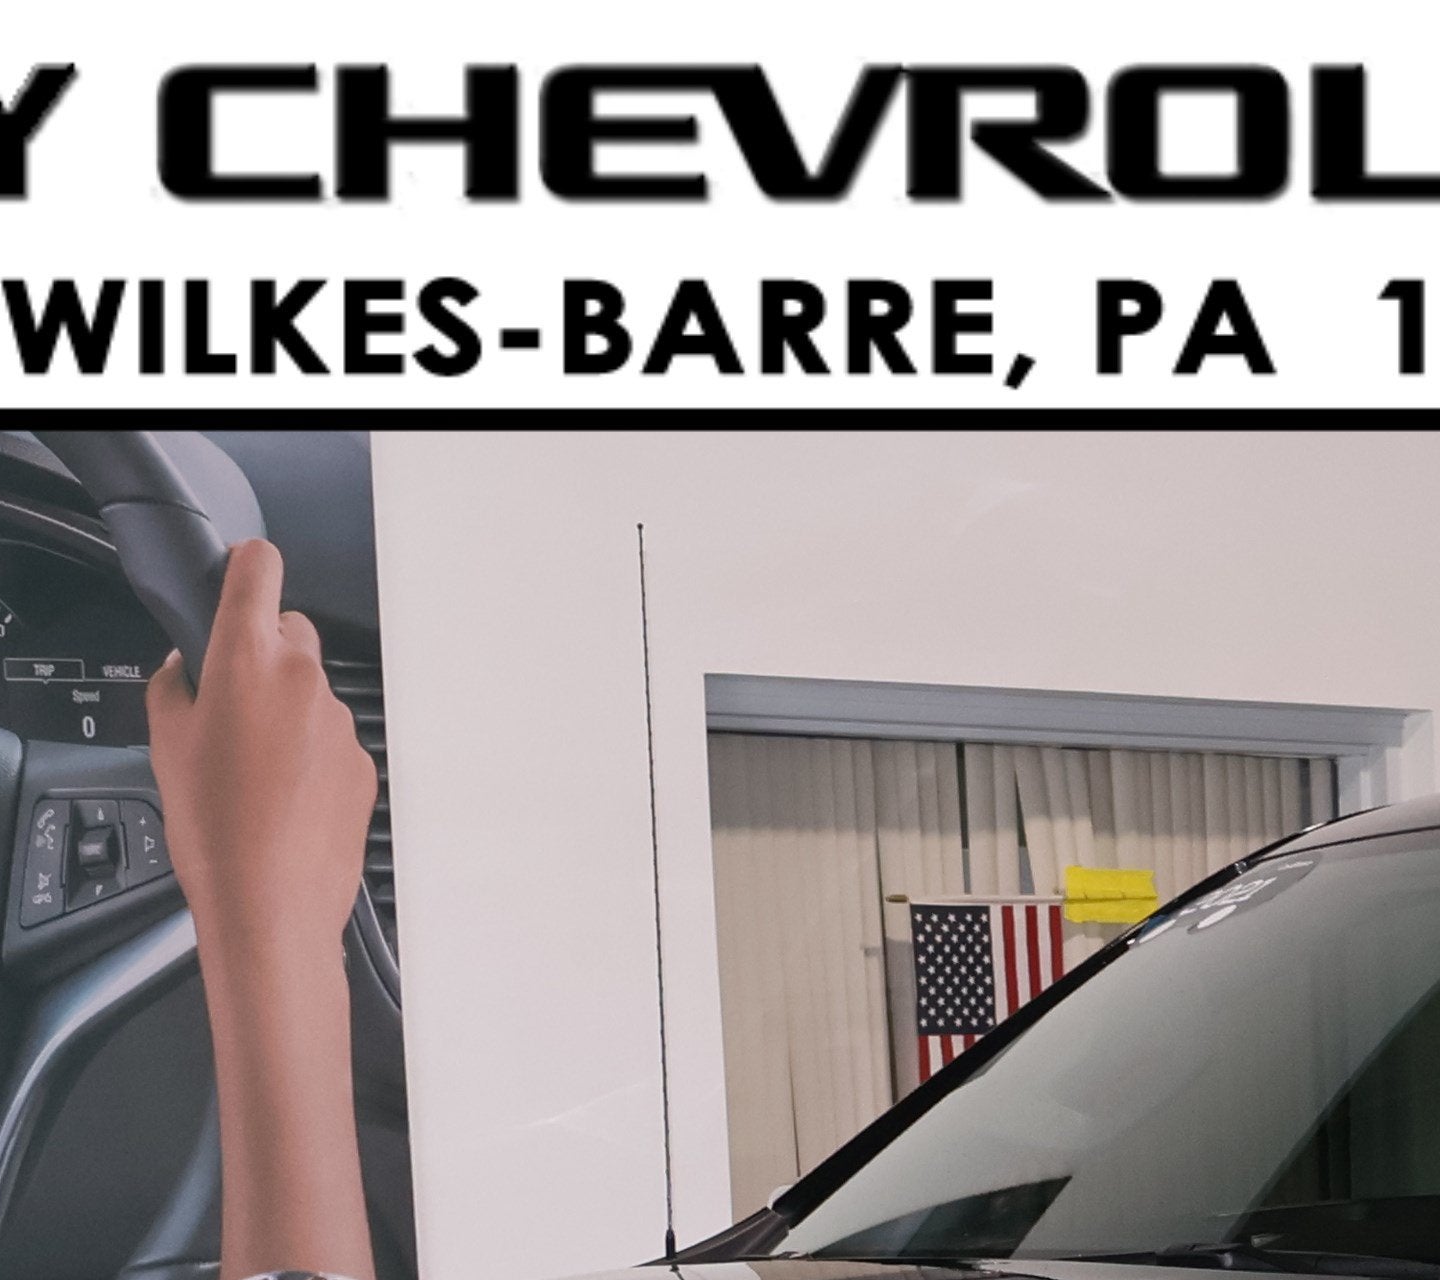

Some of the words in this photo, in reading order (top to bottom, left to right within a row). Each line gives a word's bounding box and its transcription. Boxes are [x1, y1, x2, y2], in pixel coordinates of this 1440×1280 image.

[32, 663, 56, 677] TRIP
[102, 665, 142, 679] VEHICLE
[82, 716, 96, 738] 0
